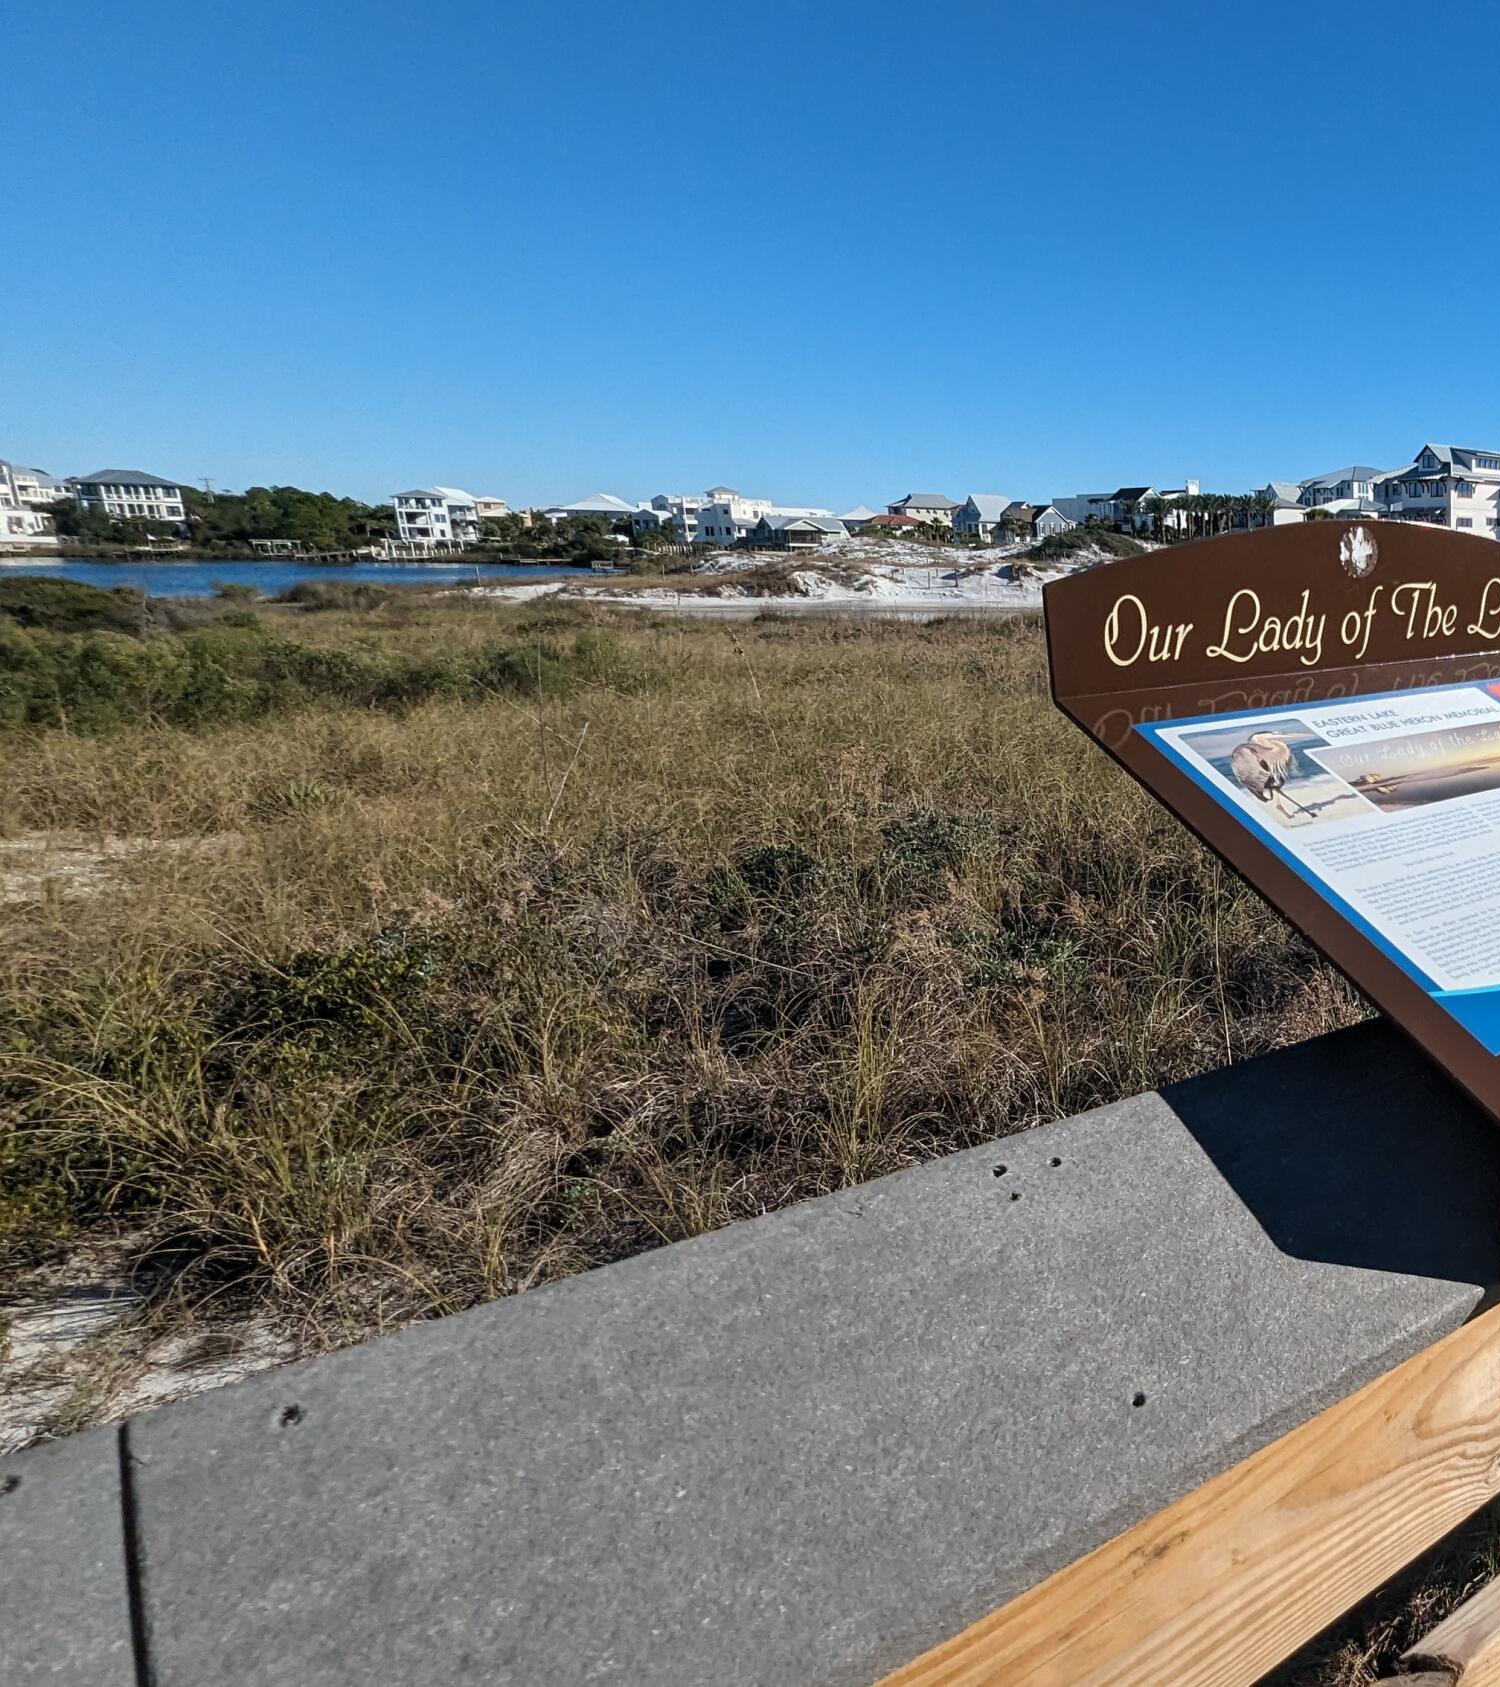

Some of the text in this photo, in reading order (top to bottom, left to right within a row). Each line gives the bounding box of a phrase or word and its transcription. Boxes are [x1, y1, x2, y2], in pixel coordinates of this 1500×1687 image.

[1104, 594, 1194, 667] Our
[1205, 588, 1327, 666] Lady
[1340, 585, 1384, 660] of
[1390, 580, 1458, 640] The
[1312, 708, 1400, 729] EASTERN LAKE
[1326, 704, 1500, 739] GREAT BLUE HERON MEMORIAL
[1340, 752, 1370, 768] Our
[1377, 740, 1426, 760] Lady
[1430, 737, 1447, 756] of
[1448, 731, 1475, 746] the
